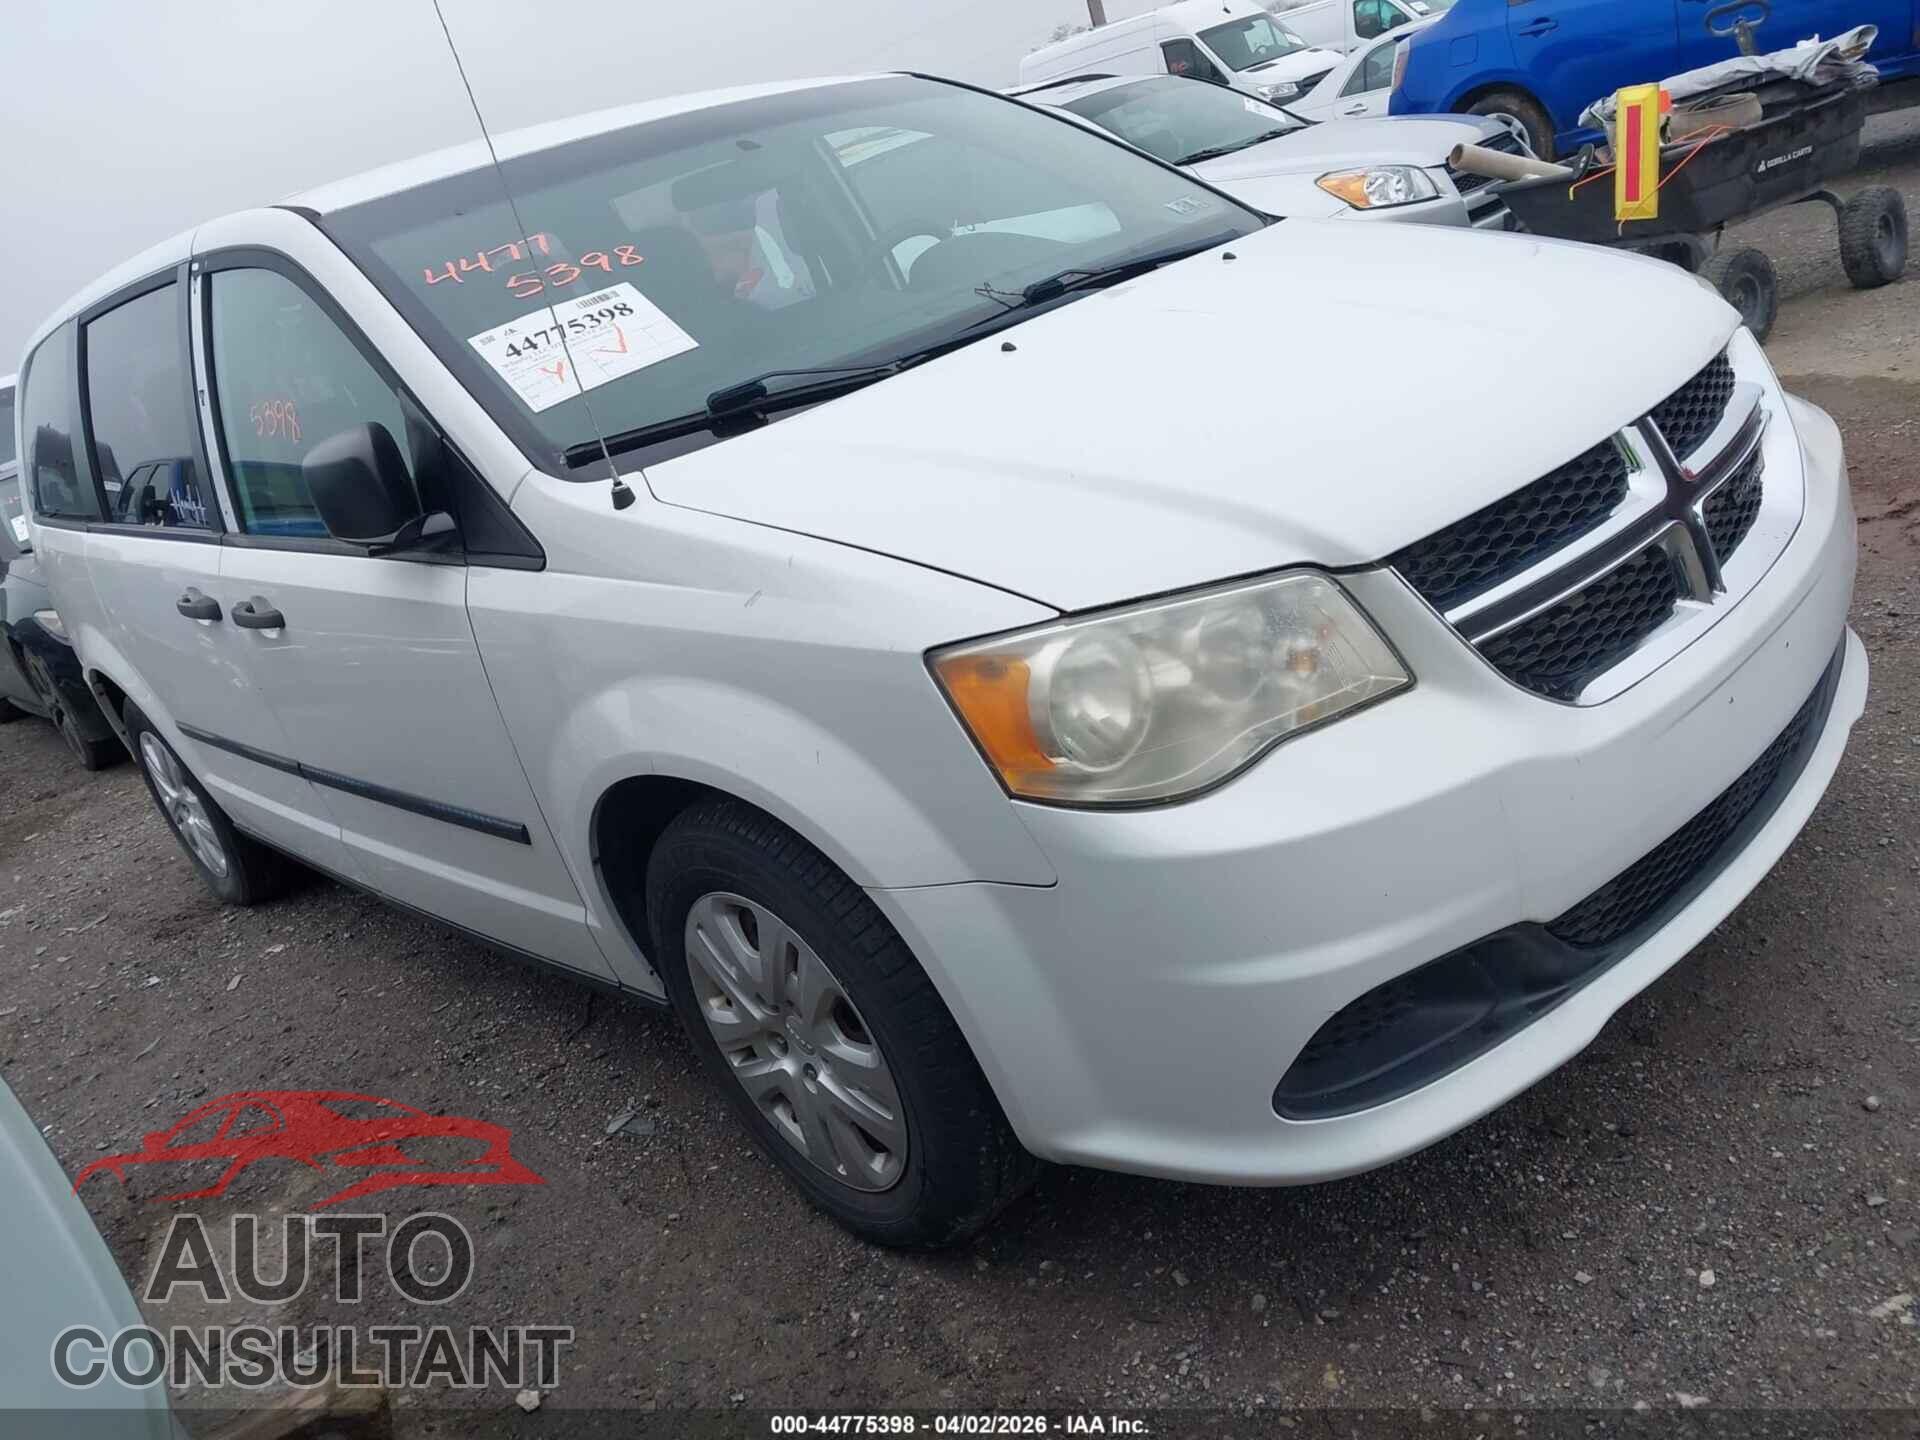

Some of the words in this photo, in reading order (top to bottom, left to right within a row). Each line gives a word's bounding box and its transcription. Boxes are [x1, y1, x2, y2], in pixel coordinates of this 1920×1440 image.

[424, 232, 550, 285] 4477
[506, 245, 644, 298] 5398
[505, 302, 634, 358] 44775398
